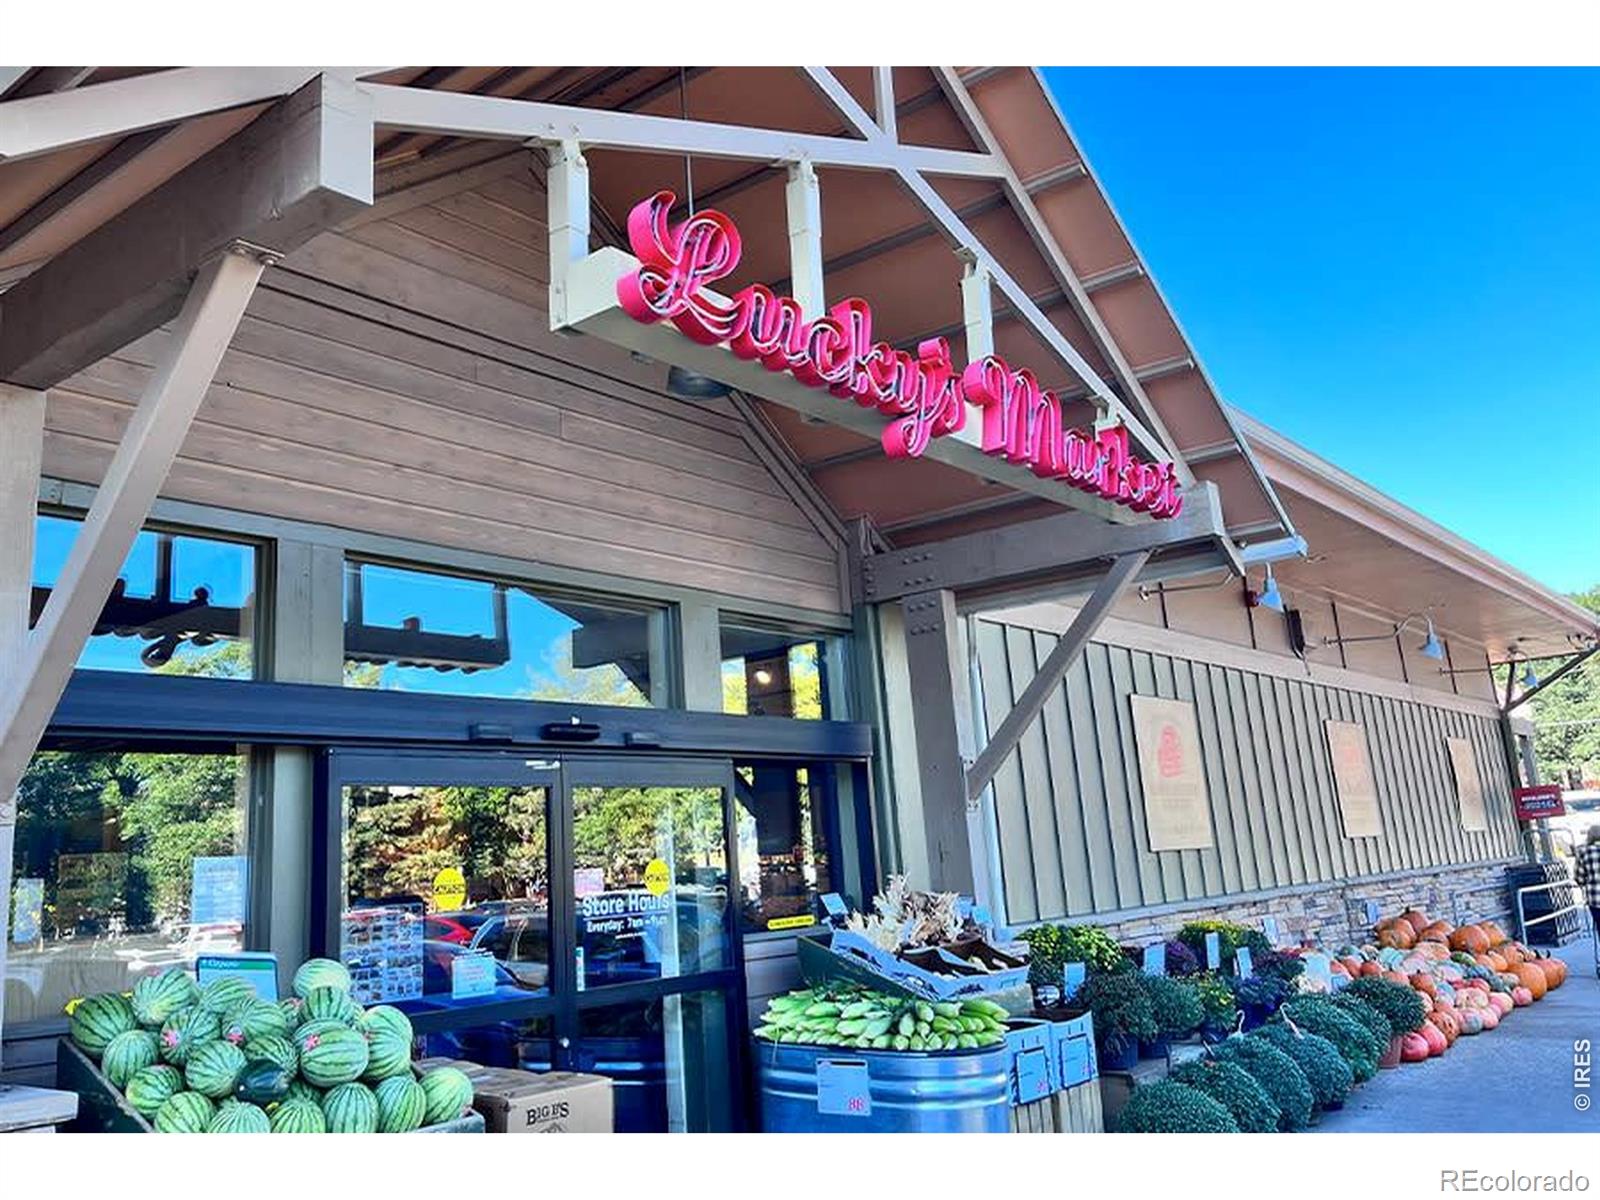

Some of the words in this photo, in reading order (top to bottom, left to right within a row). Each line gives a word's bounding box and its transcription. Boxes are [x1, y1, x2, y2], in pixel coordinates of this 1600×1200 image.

[616, 190, 966, 459] Lucky's
[963, 355, 1182, 520] Market
[583, 895, 625, 917] Store
[628, 890, 670, 912] Hours
[526, 1105, 550, 1126] BIG
